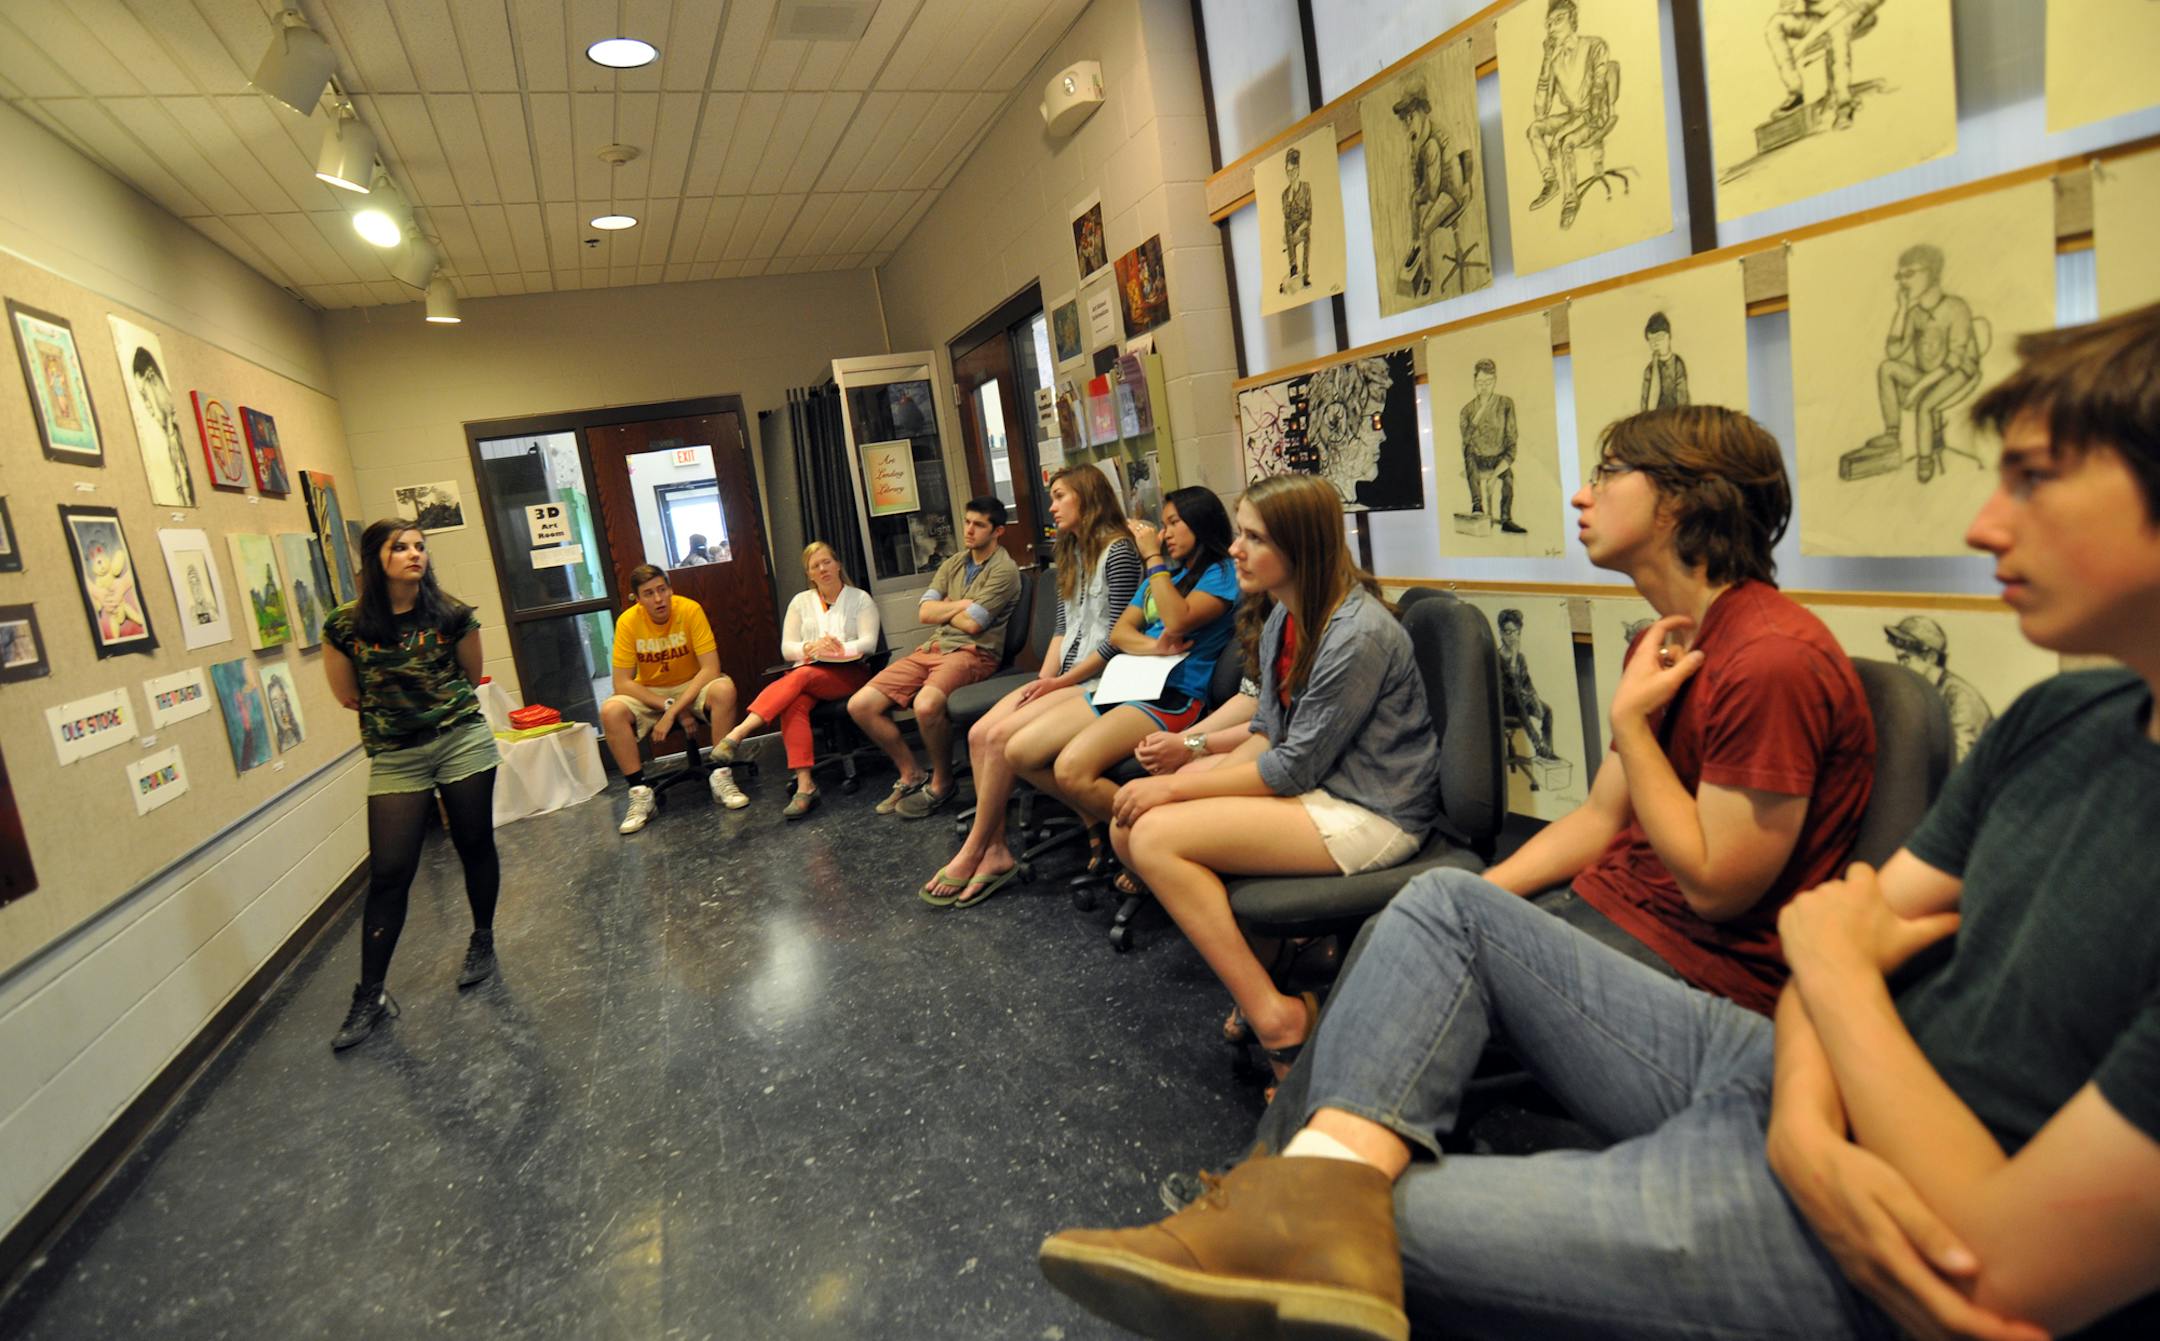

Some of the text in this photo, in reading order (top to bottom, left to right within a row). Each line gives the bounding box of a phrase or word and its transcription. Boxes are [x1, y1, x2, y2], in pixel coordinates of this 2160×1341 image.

[677, 450, 695, 463] EXIT
[534, 506, 560, 520] 3D
[538, 531, 565, 539] Room
[636, 644, 689, 663] BASEALL
